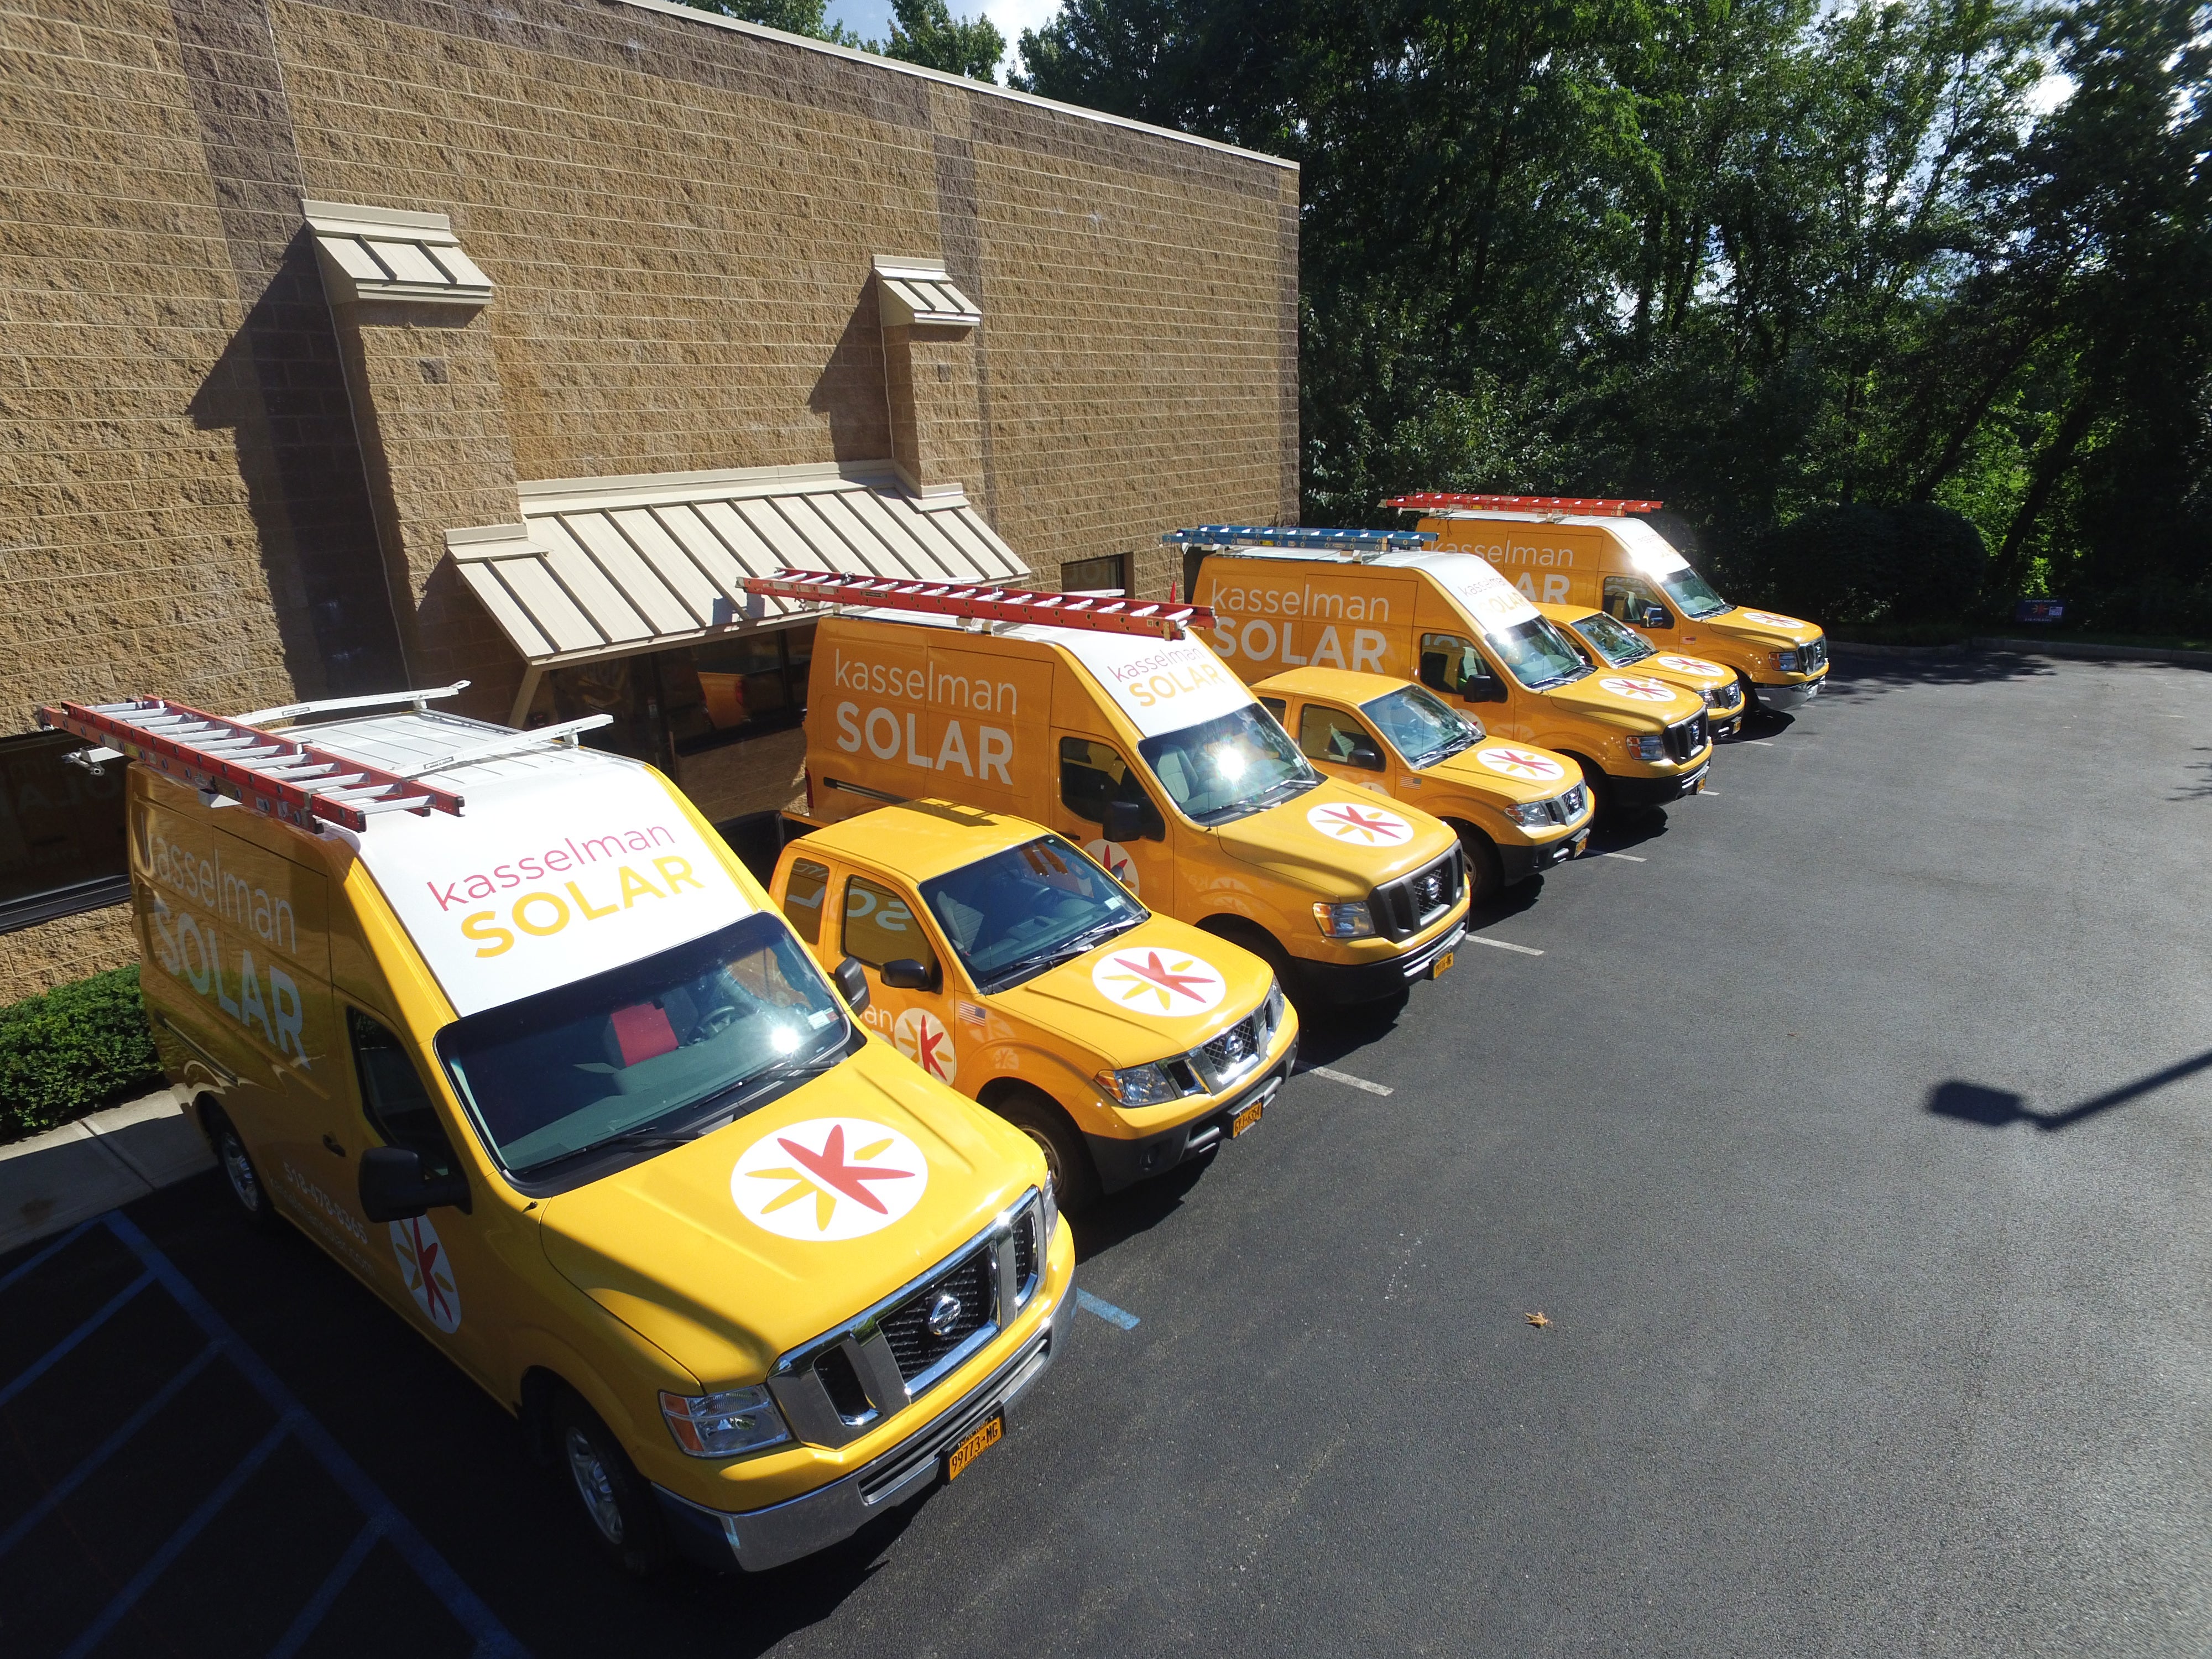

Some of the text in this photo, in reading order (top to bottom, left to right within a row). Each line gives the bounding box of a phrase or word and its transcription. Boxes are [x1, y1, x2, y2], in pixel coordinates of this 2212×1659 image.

[1212, 578, 1389, 622] kasselman
[1457, 577, 1509, 597] kasselma
[1107, 648, 1204, 682] kasselman
[1212, 617, 1386, 674] SOLAR
[836, 648, 1017, 715] kasselman
[1129, 664, 1226, 707] SOLAR
[837, 701, 1014, 786] SOLAR
[140, 811, 297, 954] kasselman
[427, 826, 675, 912] kasselman
[460, 855, 706, 958] SOLAR
[154, 893, 311, 1070] SOLAR
